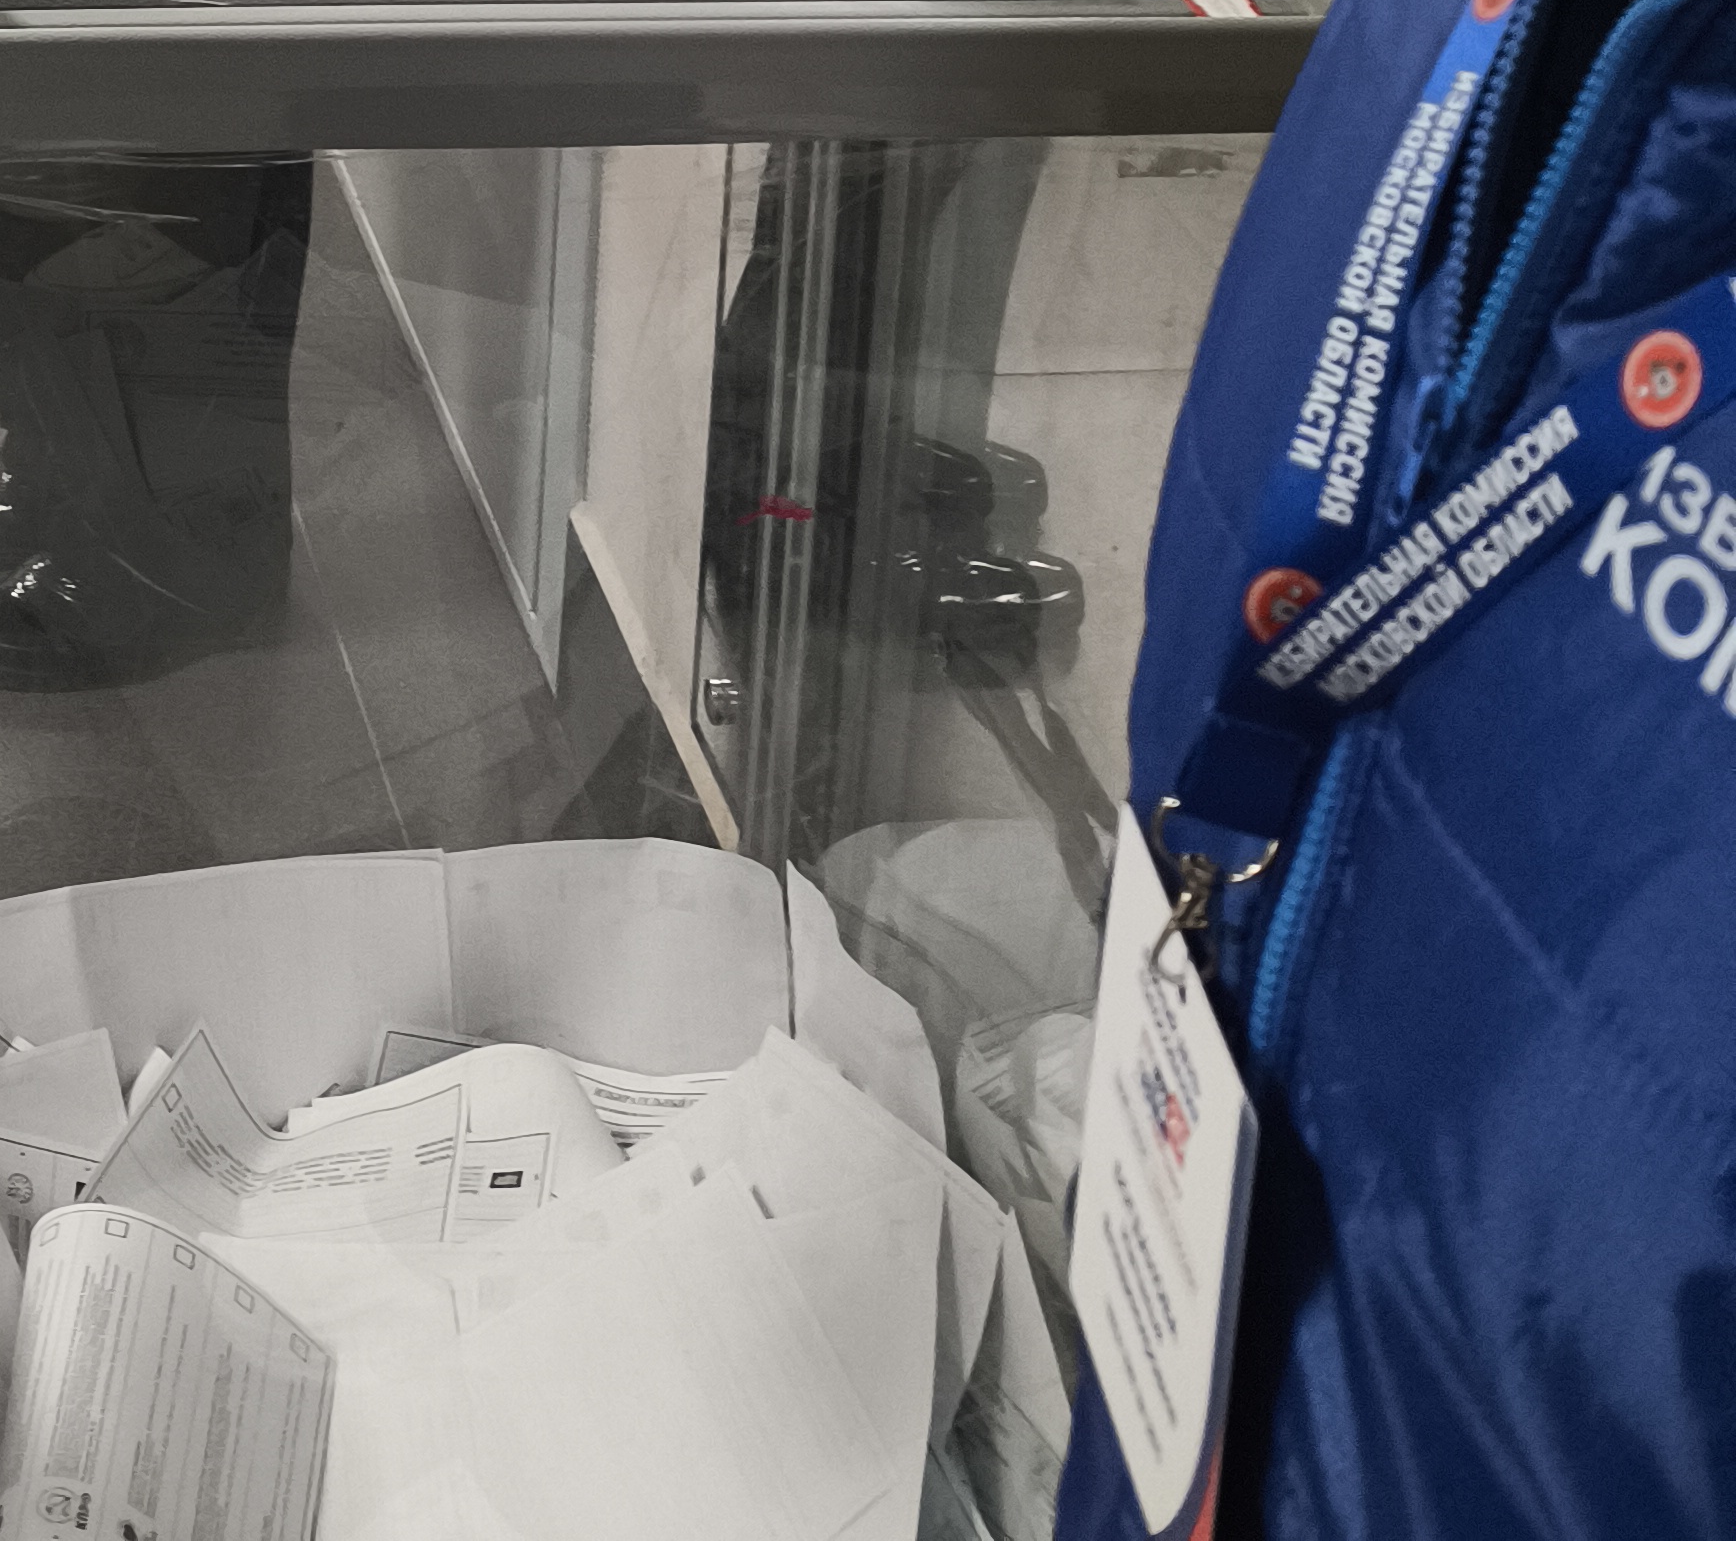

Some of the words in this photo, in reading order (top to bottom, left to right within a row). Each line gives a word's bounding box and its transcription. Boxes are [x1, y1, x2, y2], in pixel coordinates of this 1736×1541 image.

[1335, 101, 1441, 314] МОСКОВСКОЙ
[1366, 70, 1481, 333] ИЗБИРАТЕЛЬНАЯ
[1287, 316, 1359, 470] ОБЛАСТИ
[1316, 335, 1390, 526] КОМИССИЯ
[1431, 404, 1580, 545] КОМИССИЯ
[1316, 563, 1473, 703] МОСКОВСКОЙ
[1456, 472, 1575, 589] ОБЛАСТИ
